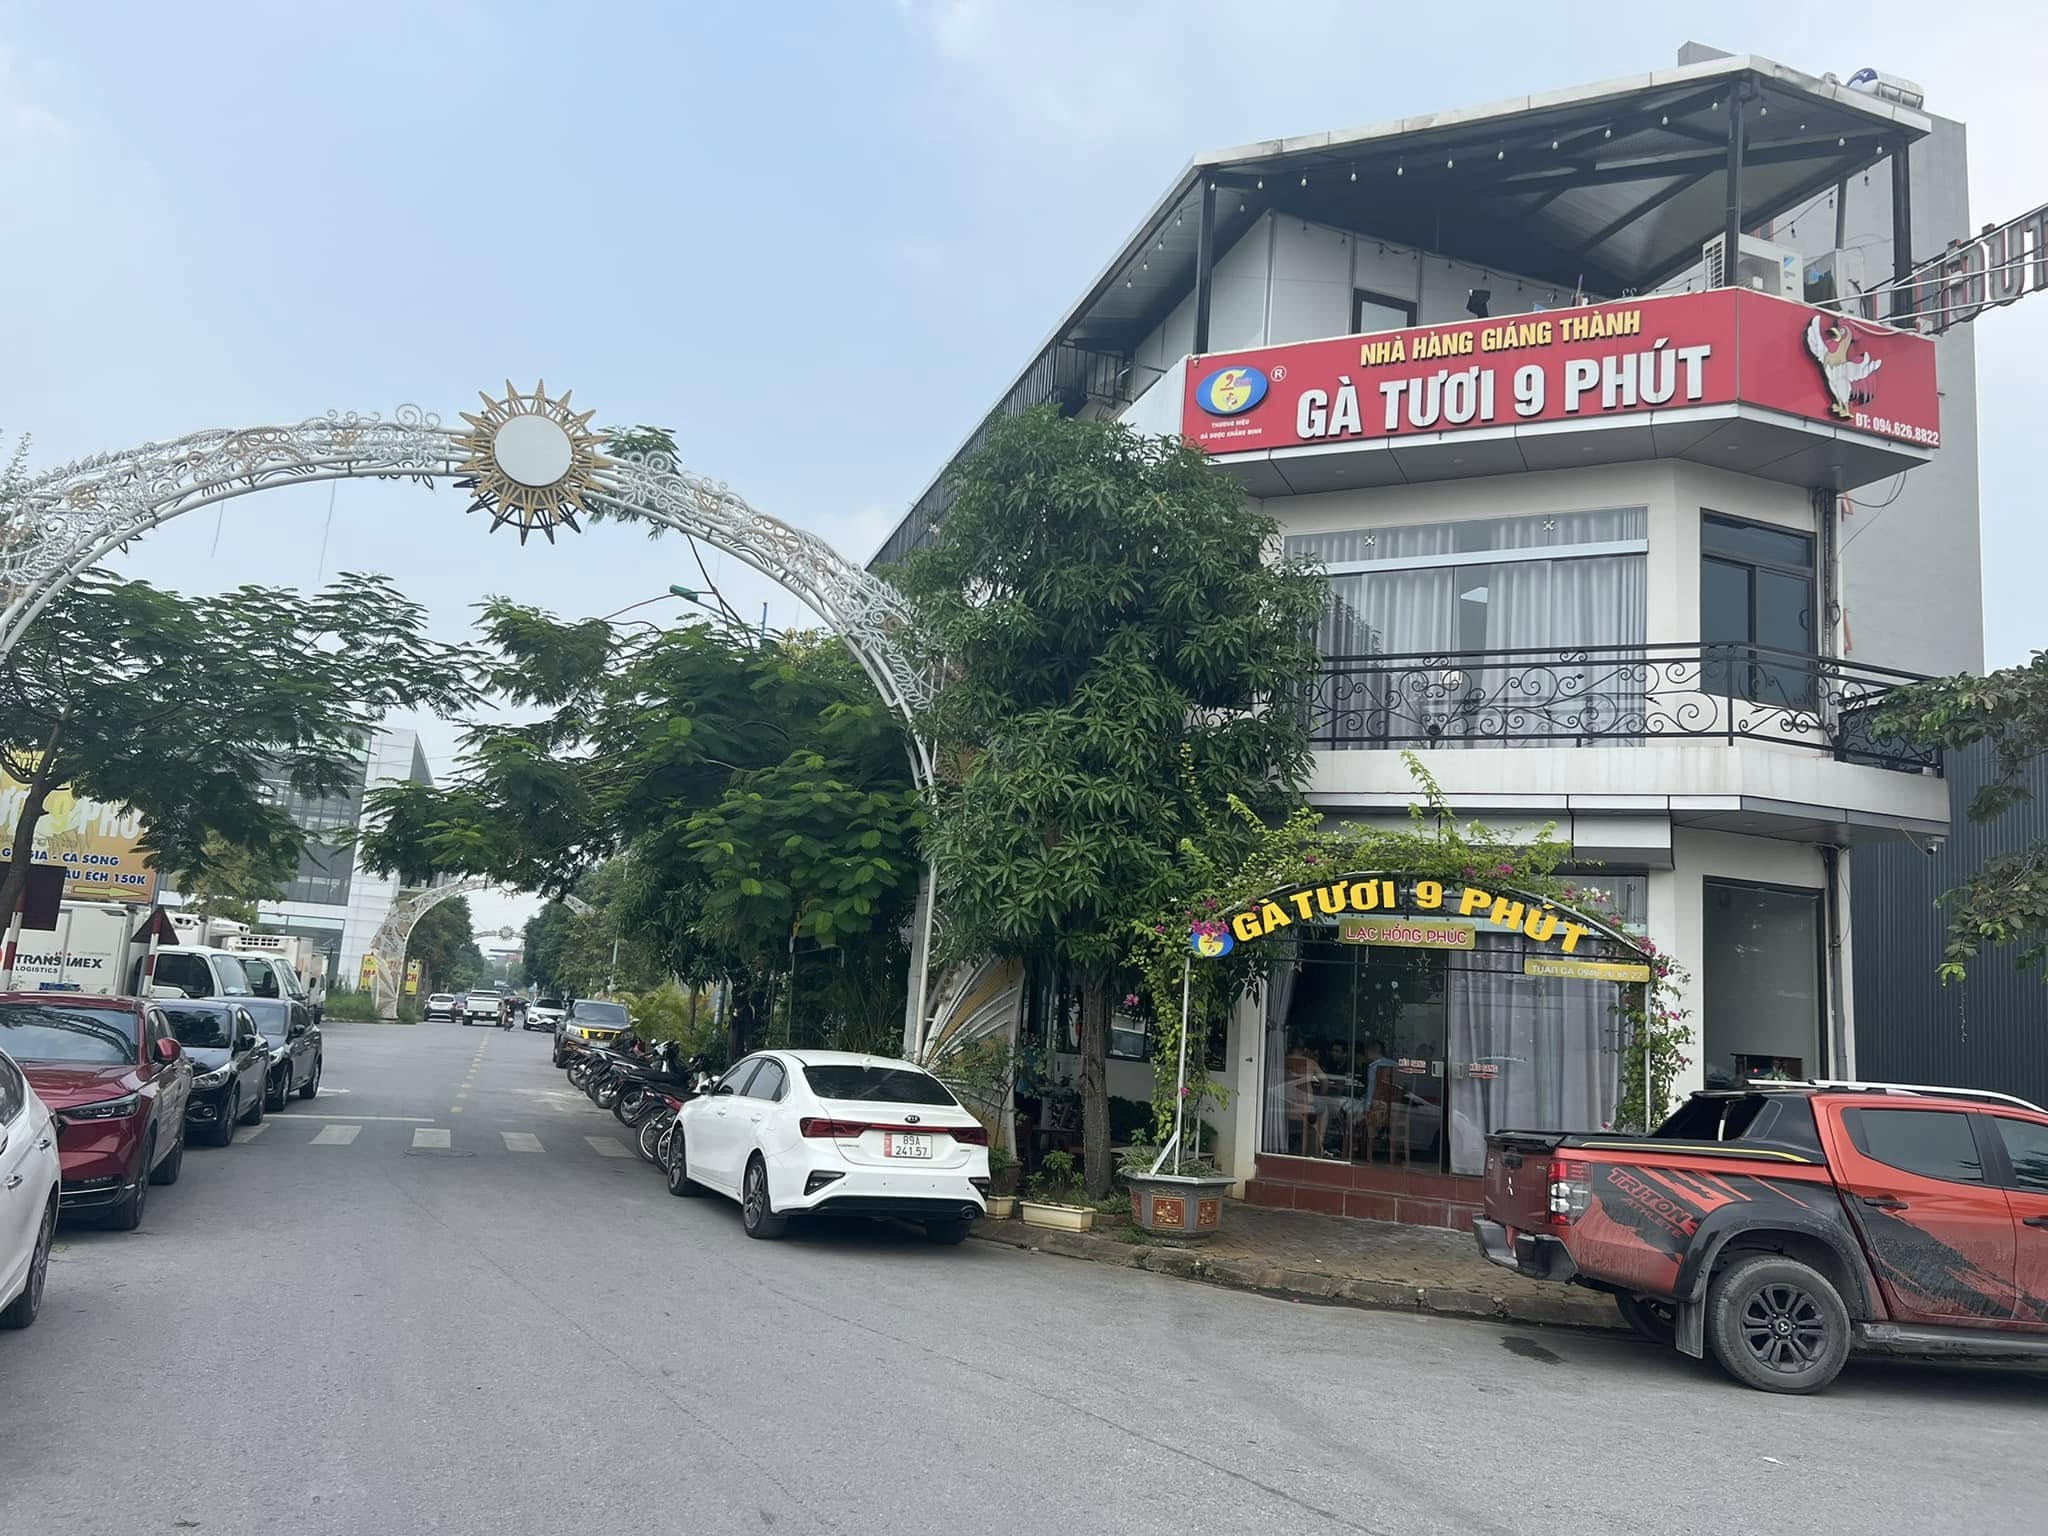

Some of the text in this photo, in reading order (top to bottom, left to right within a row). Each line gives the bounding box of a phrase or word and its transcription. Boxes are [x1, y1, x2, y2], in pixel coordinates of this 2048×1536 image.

[1360, 309, 1641, 367] NHÀ HÀNG GIÁNG THÀNH
[1296, 337, 1712, 440] GÀ TƯƠI 9 PHÚT
[1873, 416, 1940, 445] 094.626.8822
[114, 873, 146, 885] 150K
[1231, 880, 1590, 954] GÀ TƯƠI 9 PHÚT
[1345, 926, 1379, 944] LẠC
[1426, 927, 1468, 946] PHÚC
[15, 966, 58, 974] LOGISTICS
[896, 1145, 928, 1157] 241.57
[903, 1135, 921, 1146] 89A
[1607, 1167, 1694, 1228] TRITON
[1622, 1197, 1684, 1239] ATHLETE
